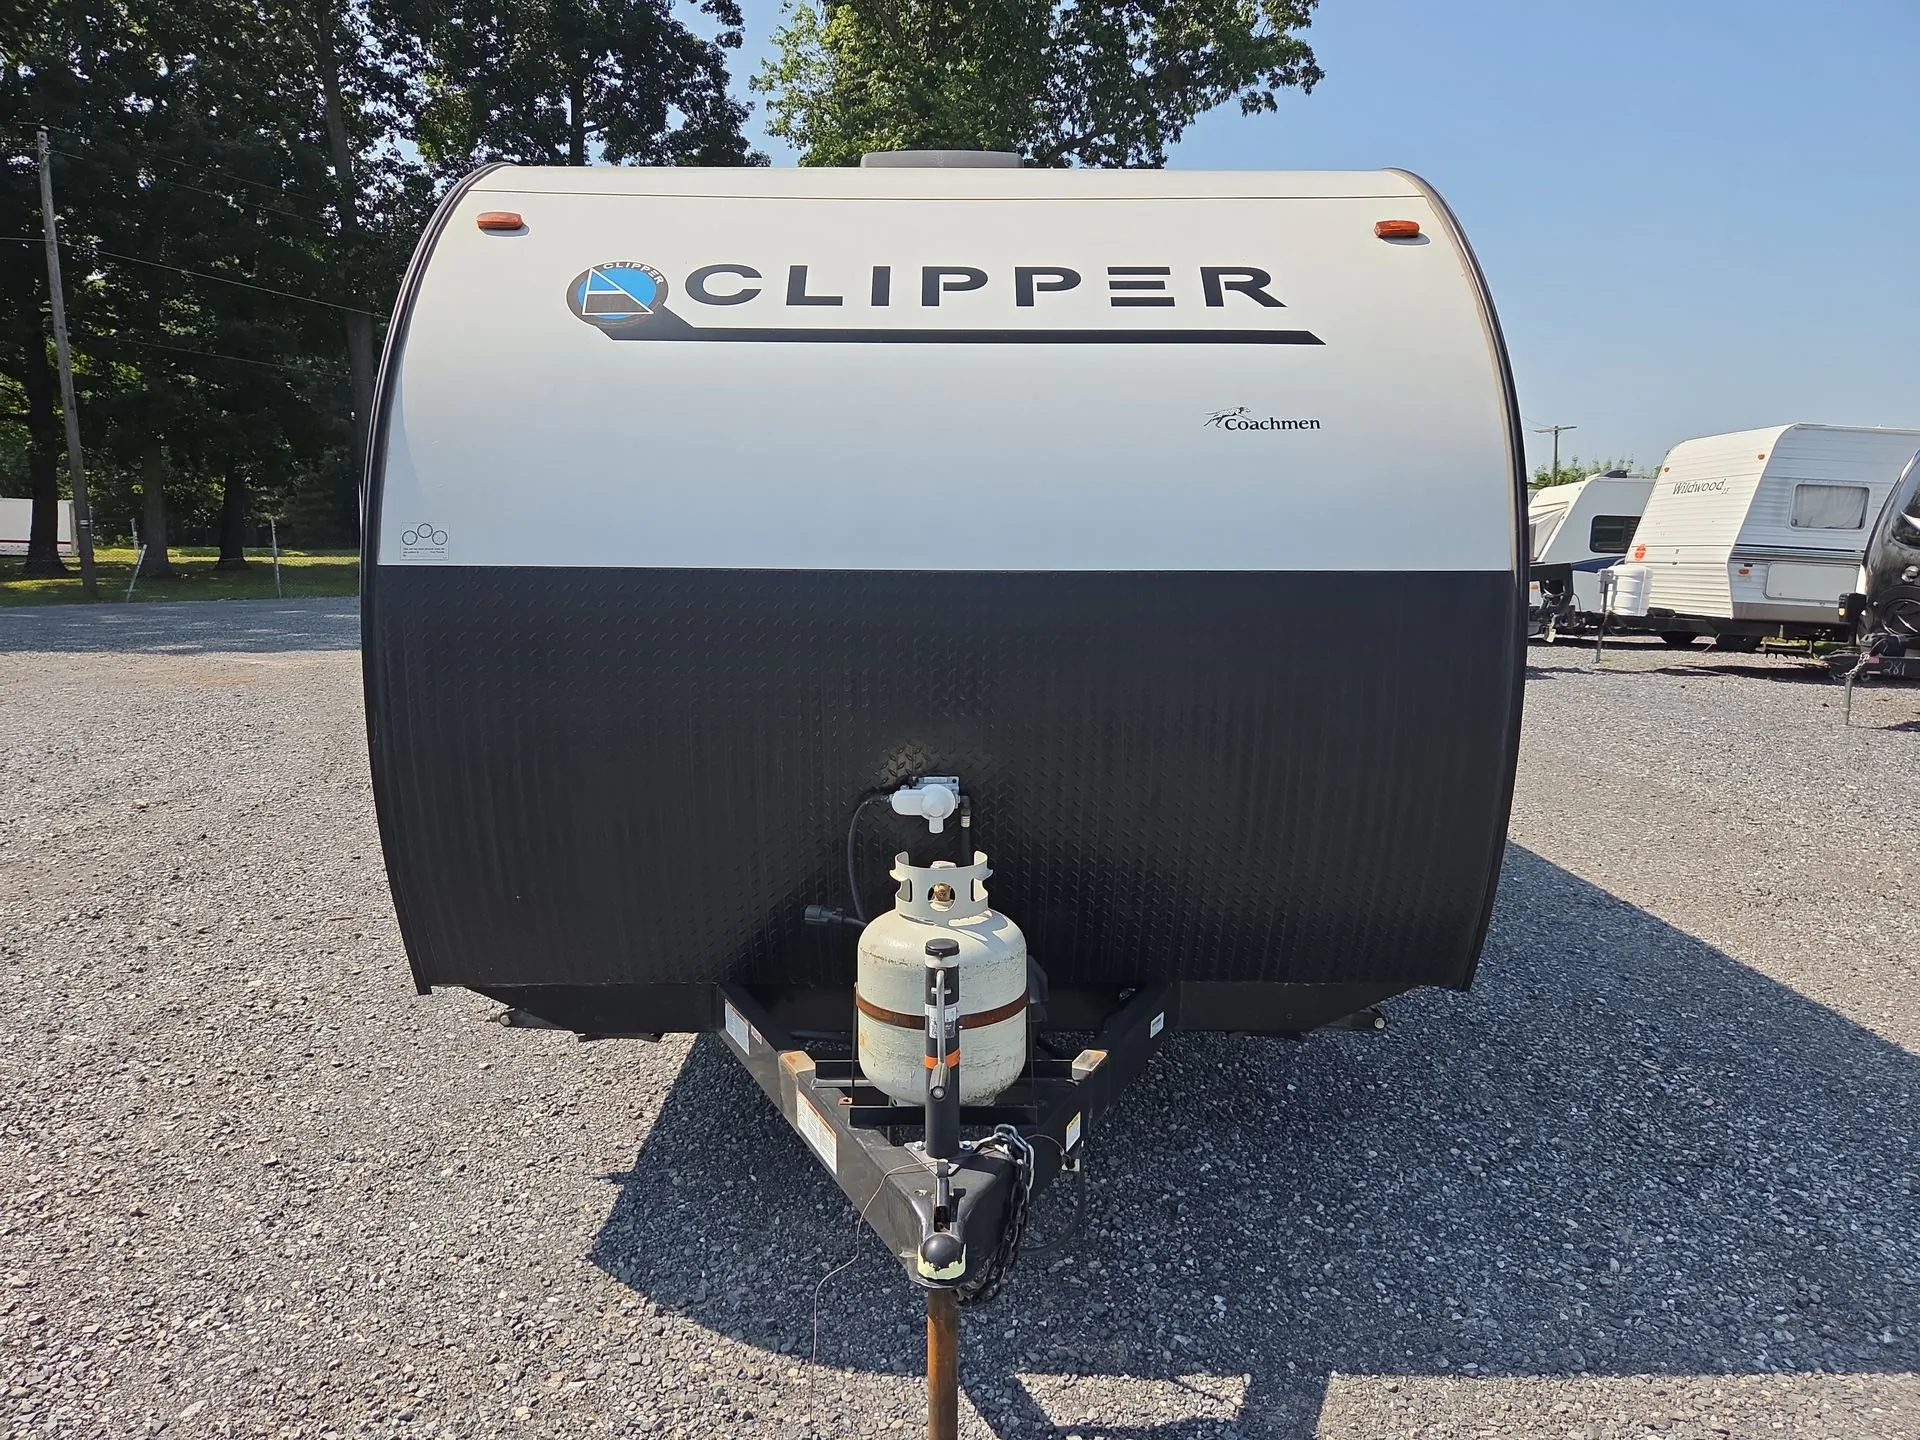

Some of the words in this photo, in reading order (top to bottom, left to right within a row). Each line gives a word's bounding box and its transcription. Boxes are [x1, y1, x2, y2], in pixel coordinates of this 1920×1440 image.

[603, 262, 664, 284] CLIPPER
[684, 263, 1289, 308] CLIPPER
[1224, 417, 1321, 431] Coachmen
[1672, 478, 1727, 495] Wildwood
